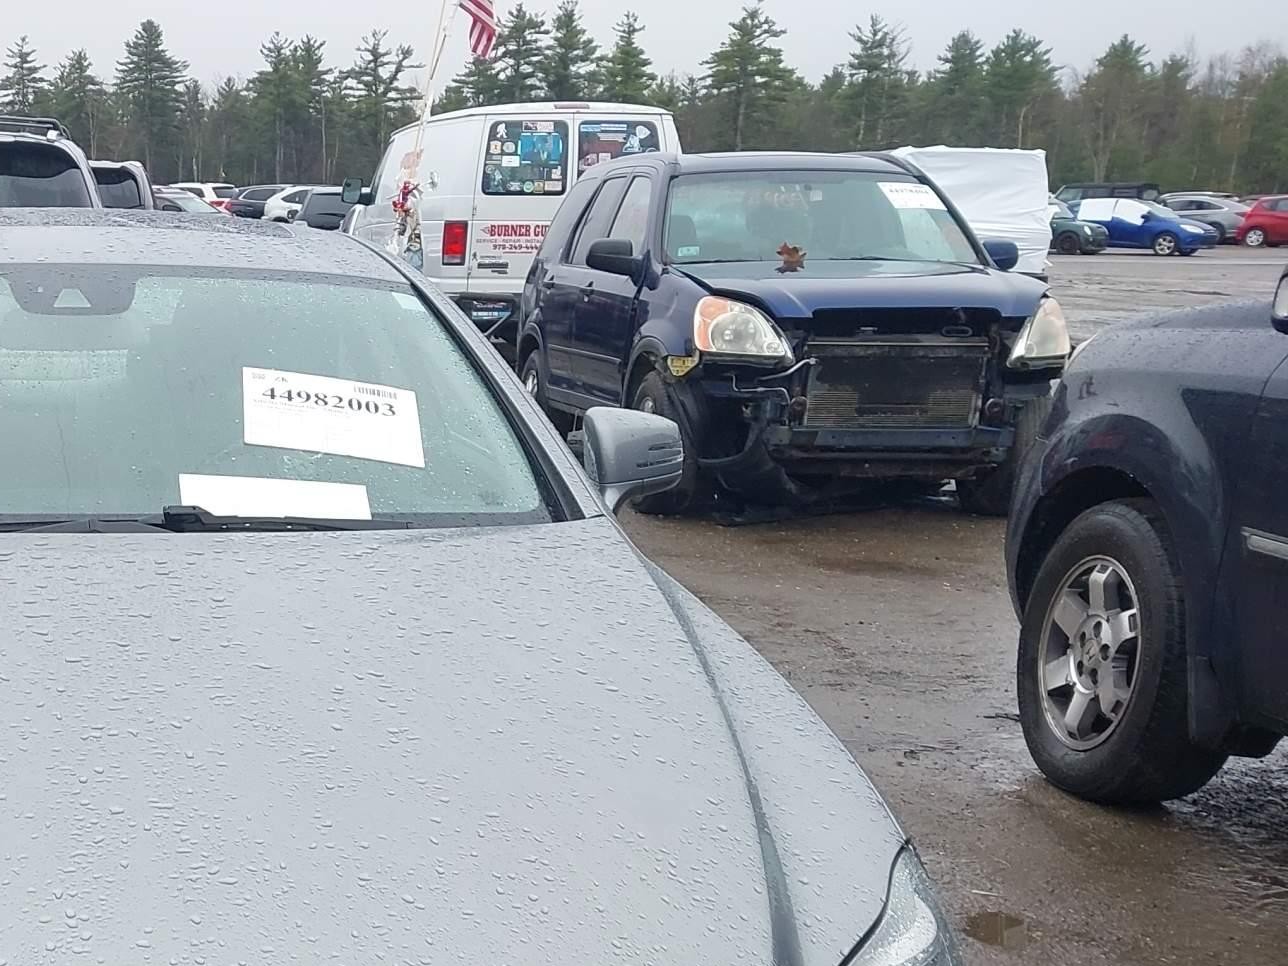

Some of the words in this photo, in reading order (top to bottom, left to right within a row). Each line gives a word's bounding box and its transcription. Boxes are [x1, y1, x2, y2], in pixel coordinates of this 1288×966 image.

[490, 225, 531, 237] BURNER
[534, 225, 550, 237] GU
[261, 387, 397, 416] 44982003
